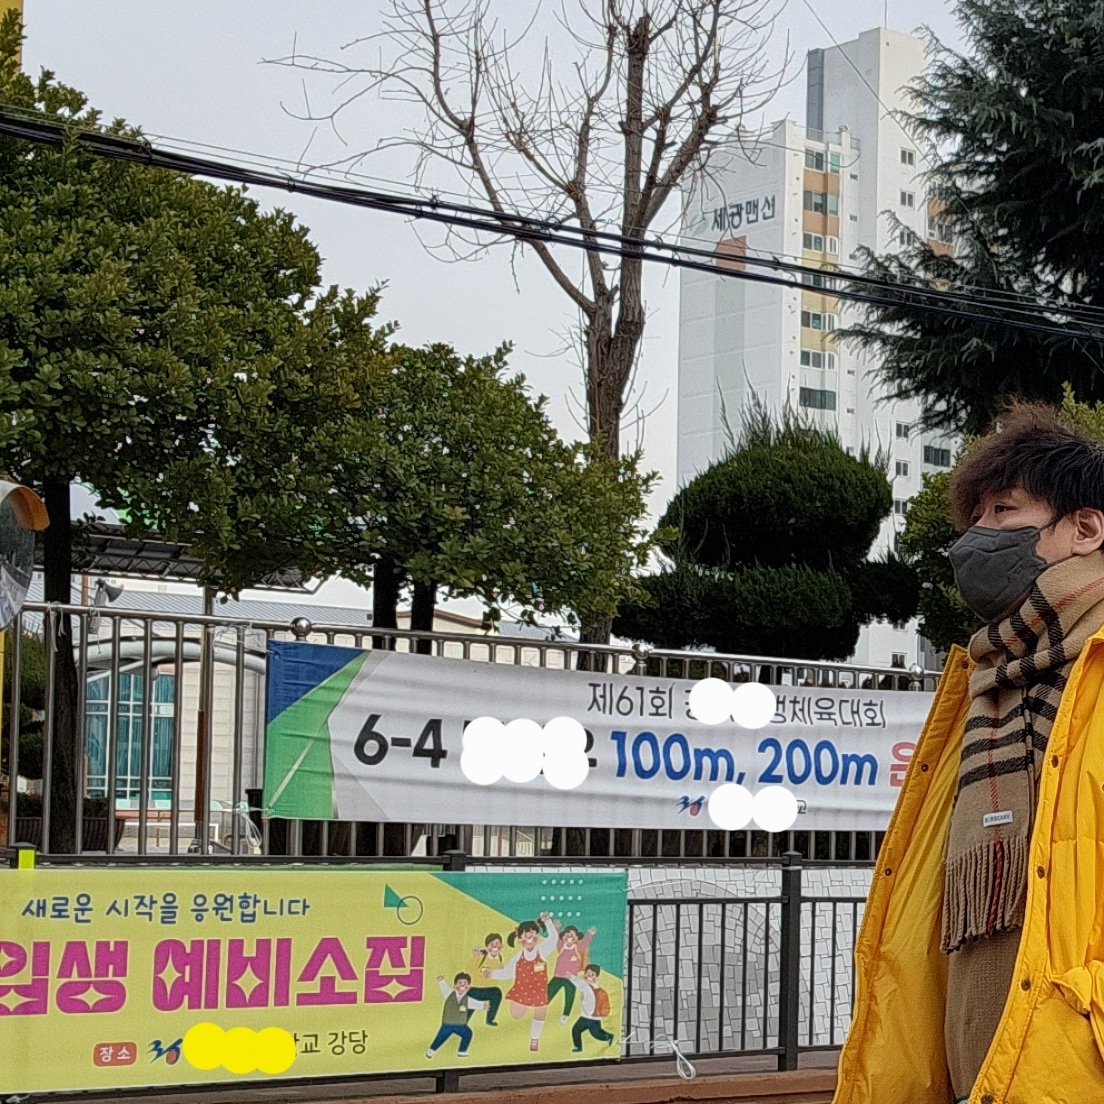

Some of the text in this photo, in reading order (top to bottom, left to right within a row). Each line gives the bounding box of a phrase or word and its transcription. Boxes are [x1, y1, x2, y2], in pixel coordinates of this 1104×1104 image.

[711, 194, 775, 231] 세광맨션
[587, 682, 673, 719] 제61회
[354, 714, 448, 768] 6-4
[610, 731, 746, 784] 100m,
[757, 737, 878, 786] 200m
[21, 892, 310, 924] 새로운 시작을 응원합니다
[152, 936, 425, 1012] 예비소집
[327, 1030, 368, 1056] 강당
